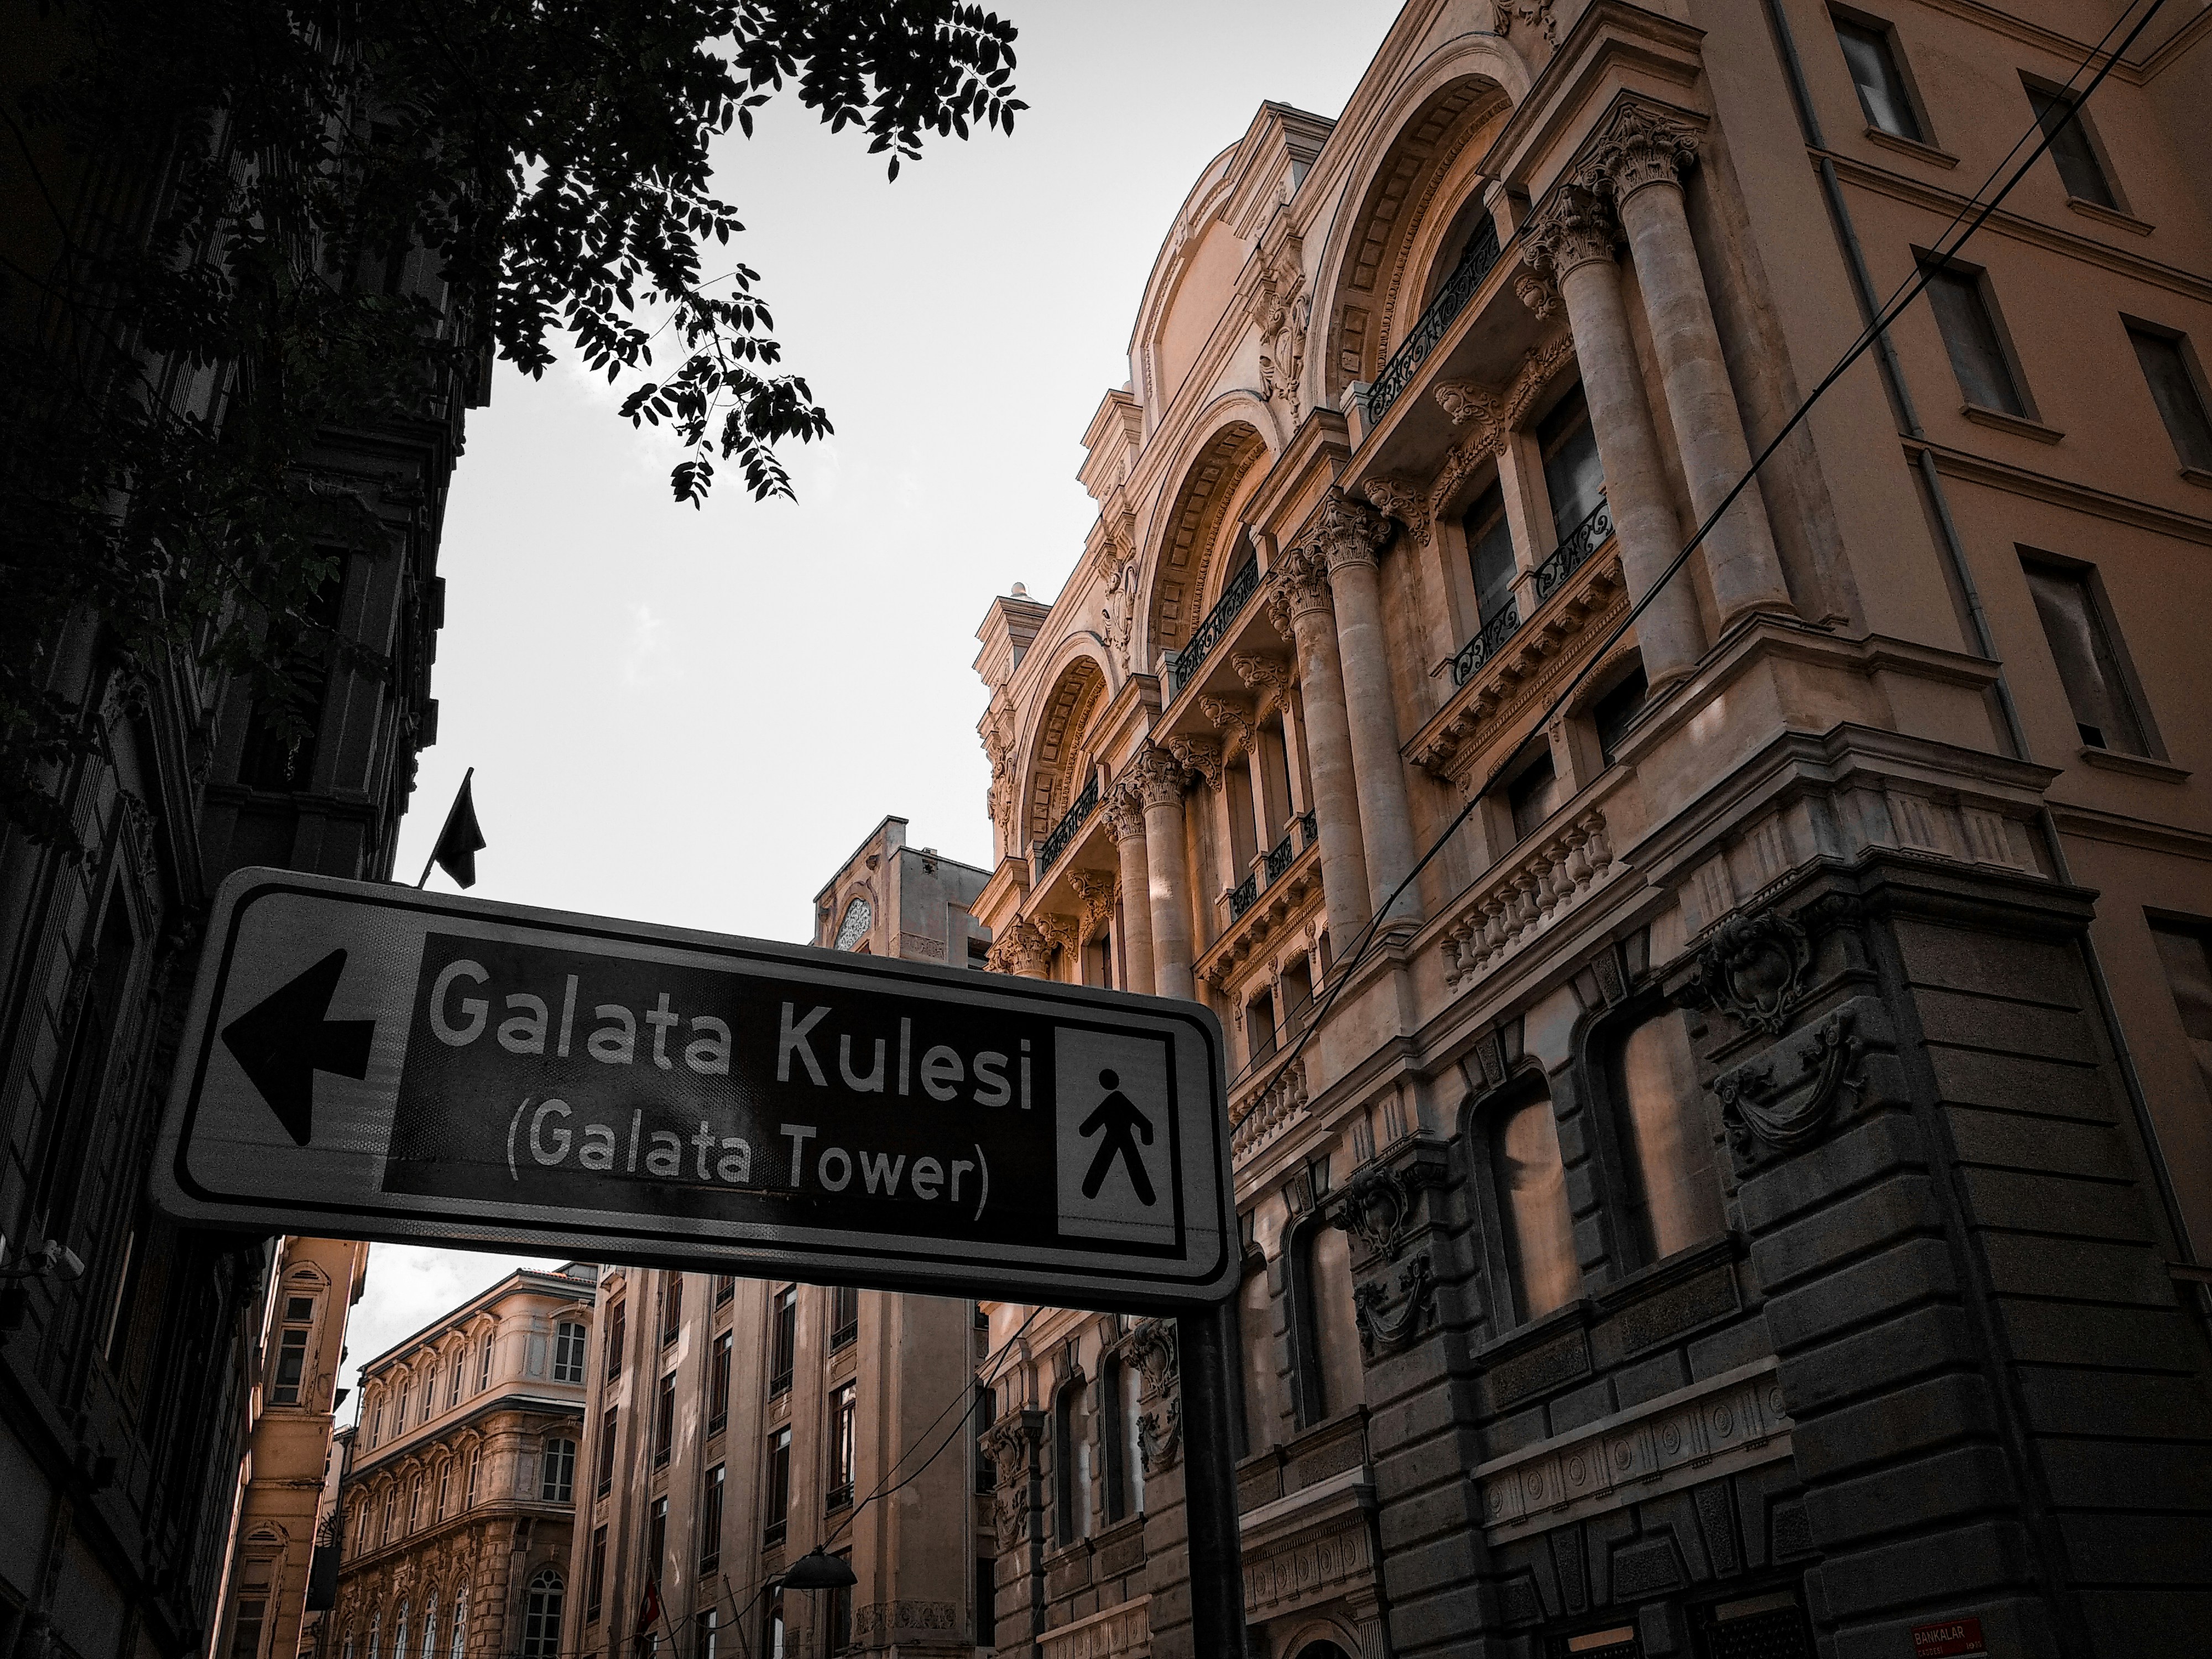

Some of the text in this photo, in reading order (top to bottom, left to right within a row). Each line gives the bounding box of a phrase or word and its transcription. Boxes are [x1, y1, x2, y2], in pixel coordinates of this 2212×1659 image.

[429, 958, 1032, 1110] Galata Kulesi
[507, 1098, 989, 1221] (Galata Tower)
[1914, 1626, 1965, 1645] BANKALAR
